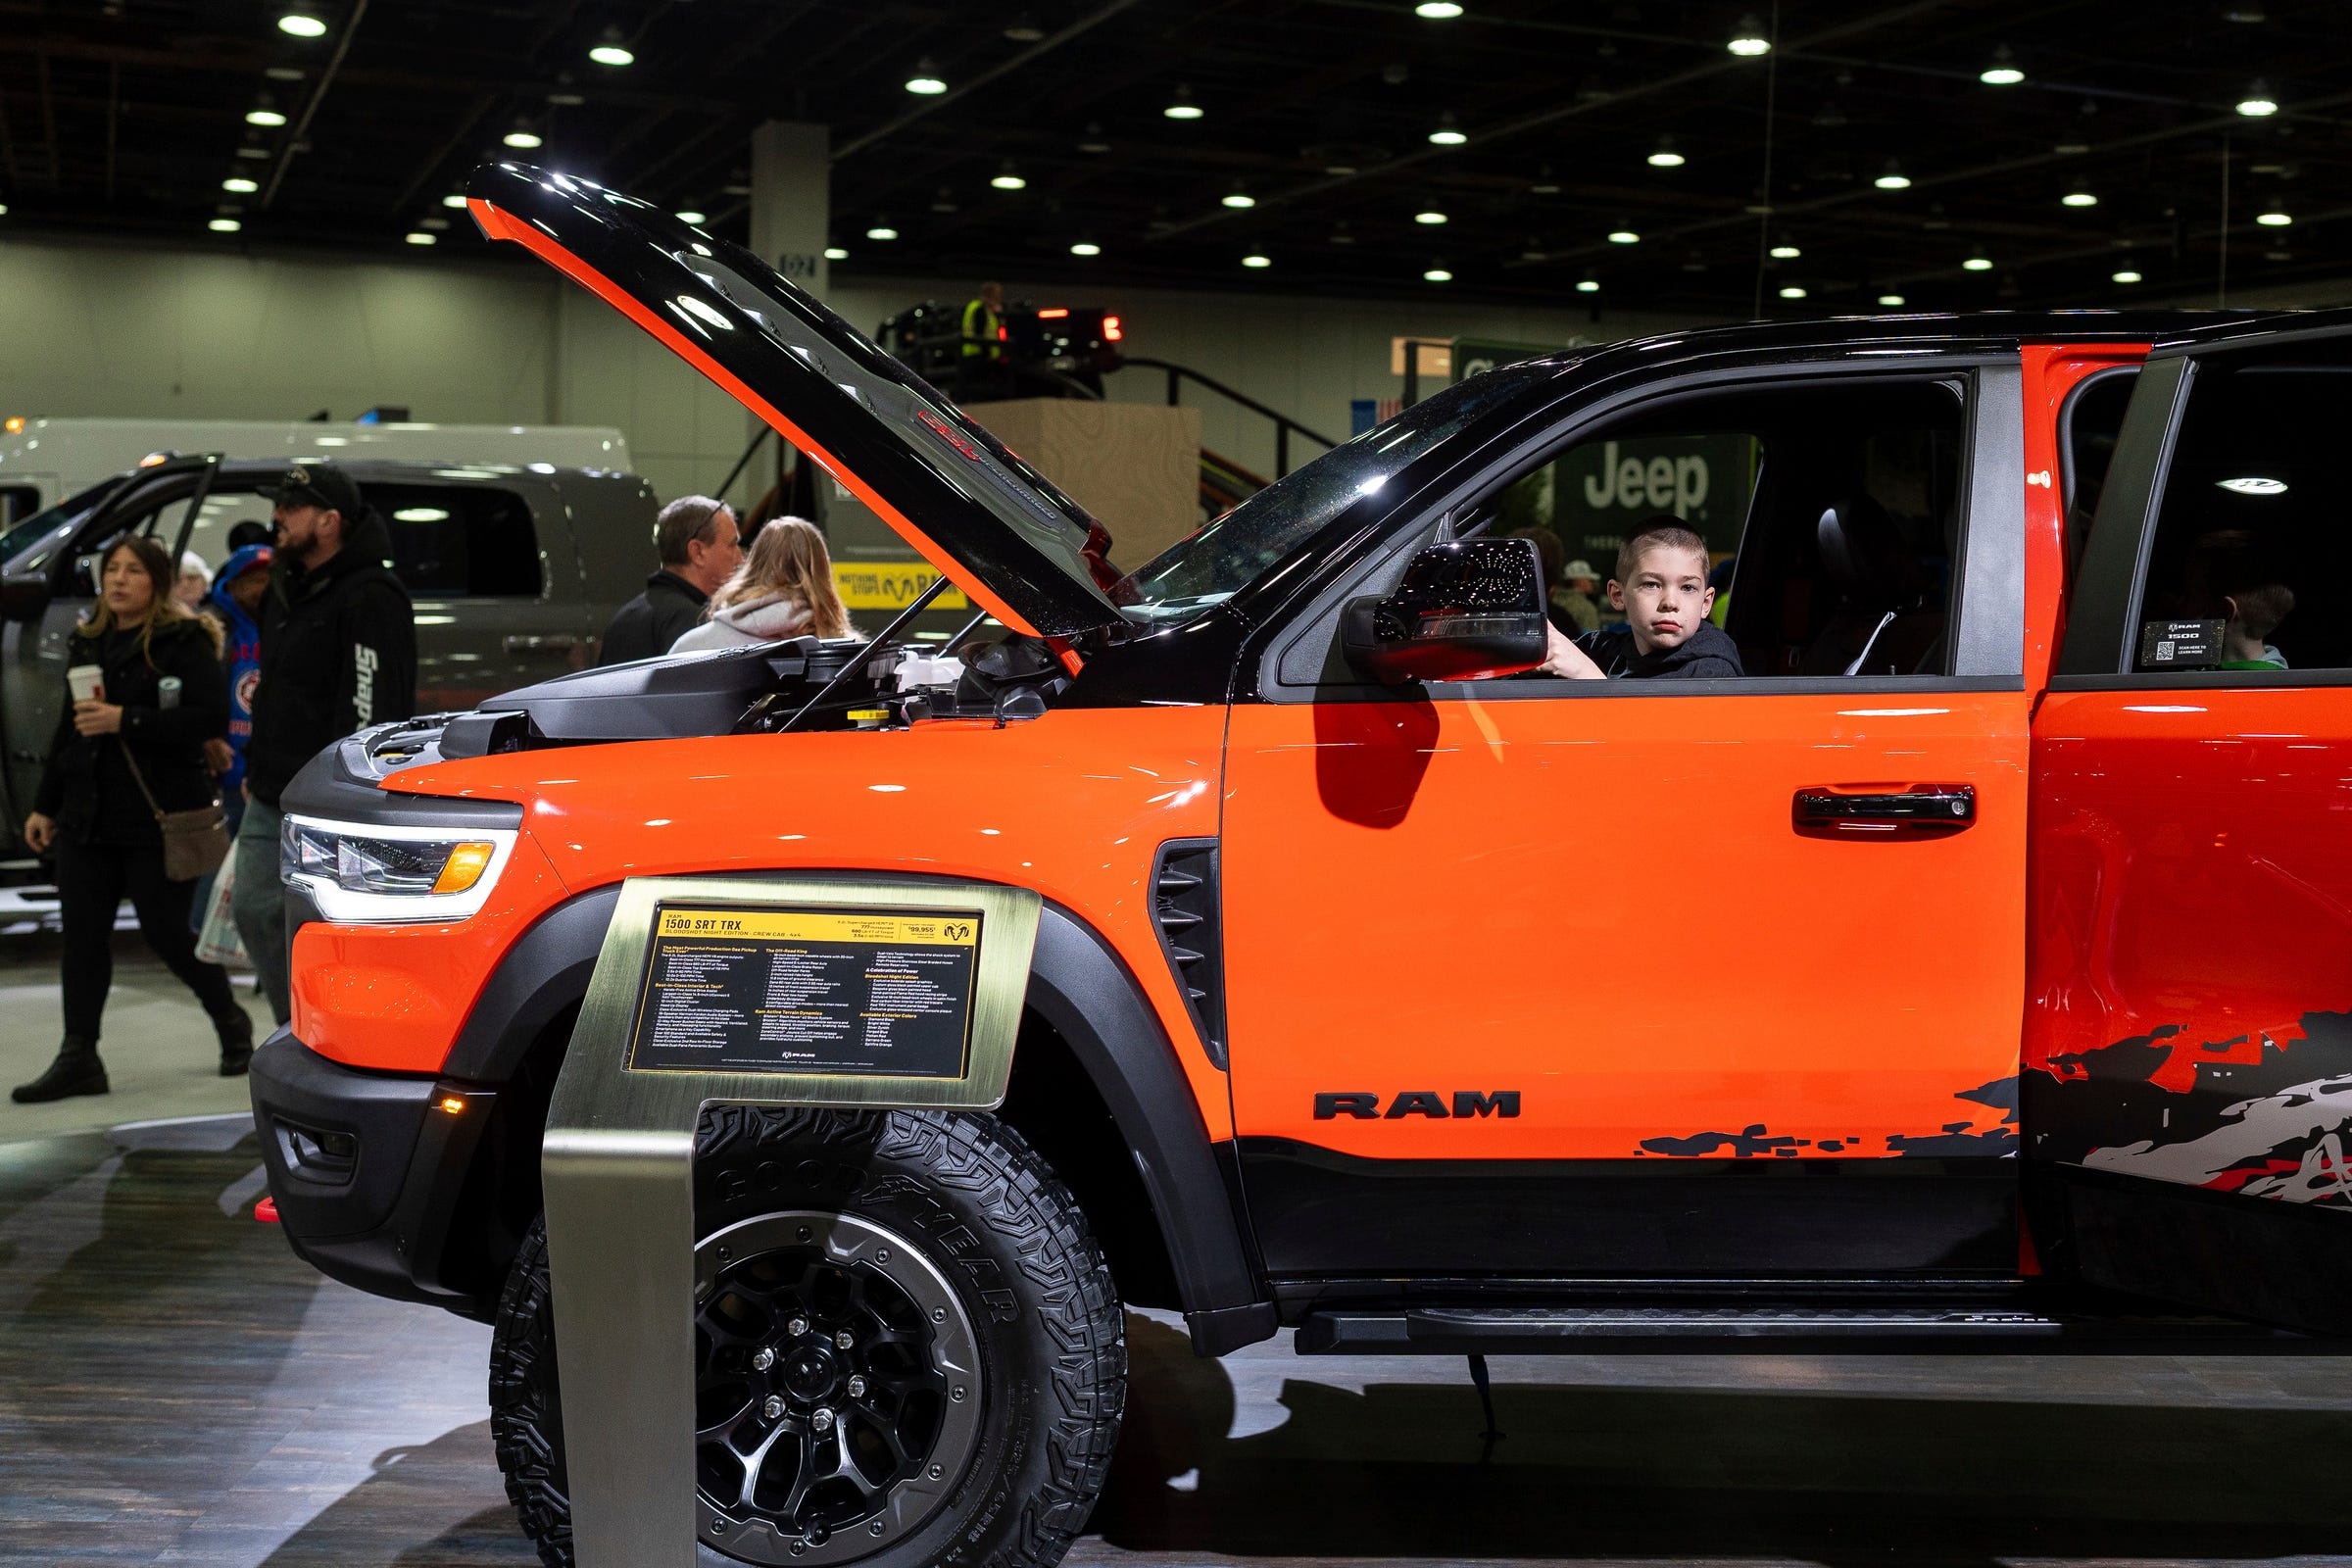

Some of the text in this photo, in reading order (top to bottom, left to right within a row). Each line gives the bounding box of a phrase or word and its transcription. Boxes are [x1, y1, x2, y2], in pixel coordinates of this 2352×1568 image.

[972, 450, 1057, 520] SUPERCHARGED
[1583, 440, 1709, 520] Jeep
[665, 919, 742, 931] 1500 SRT TRX
[1313, 1090, 1521, 1120] RAM
